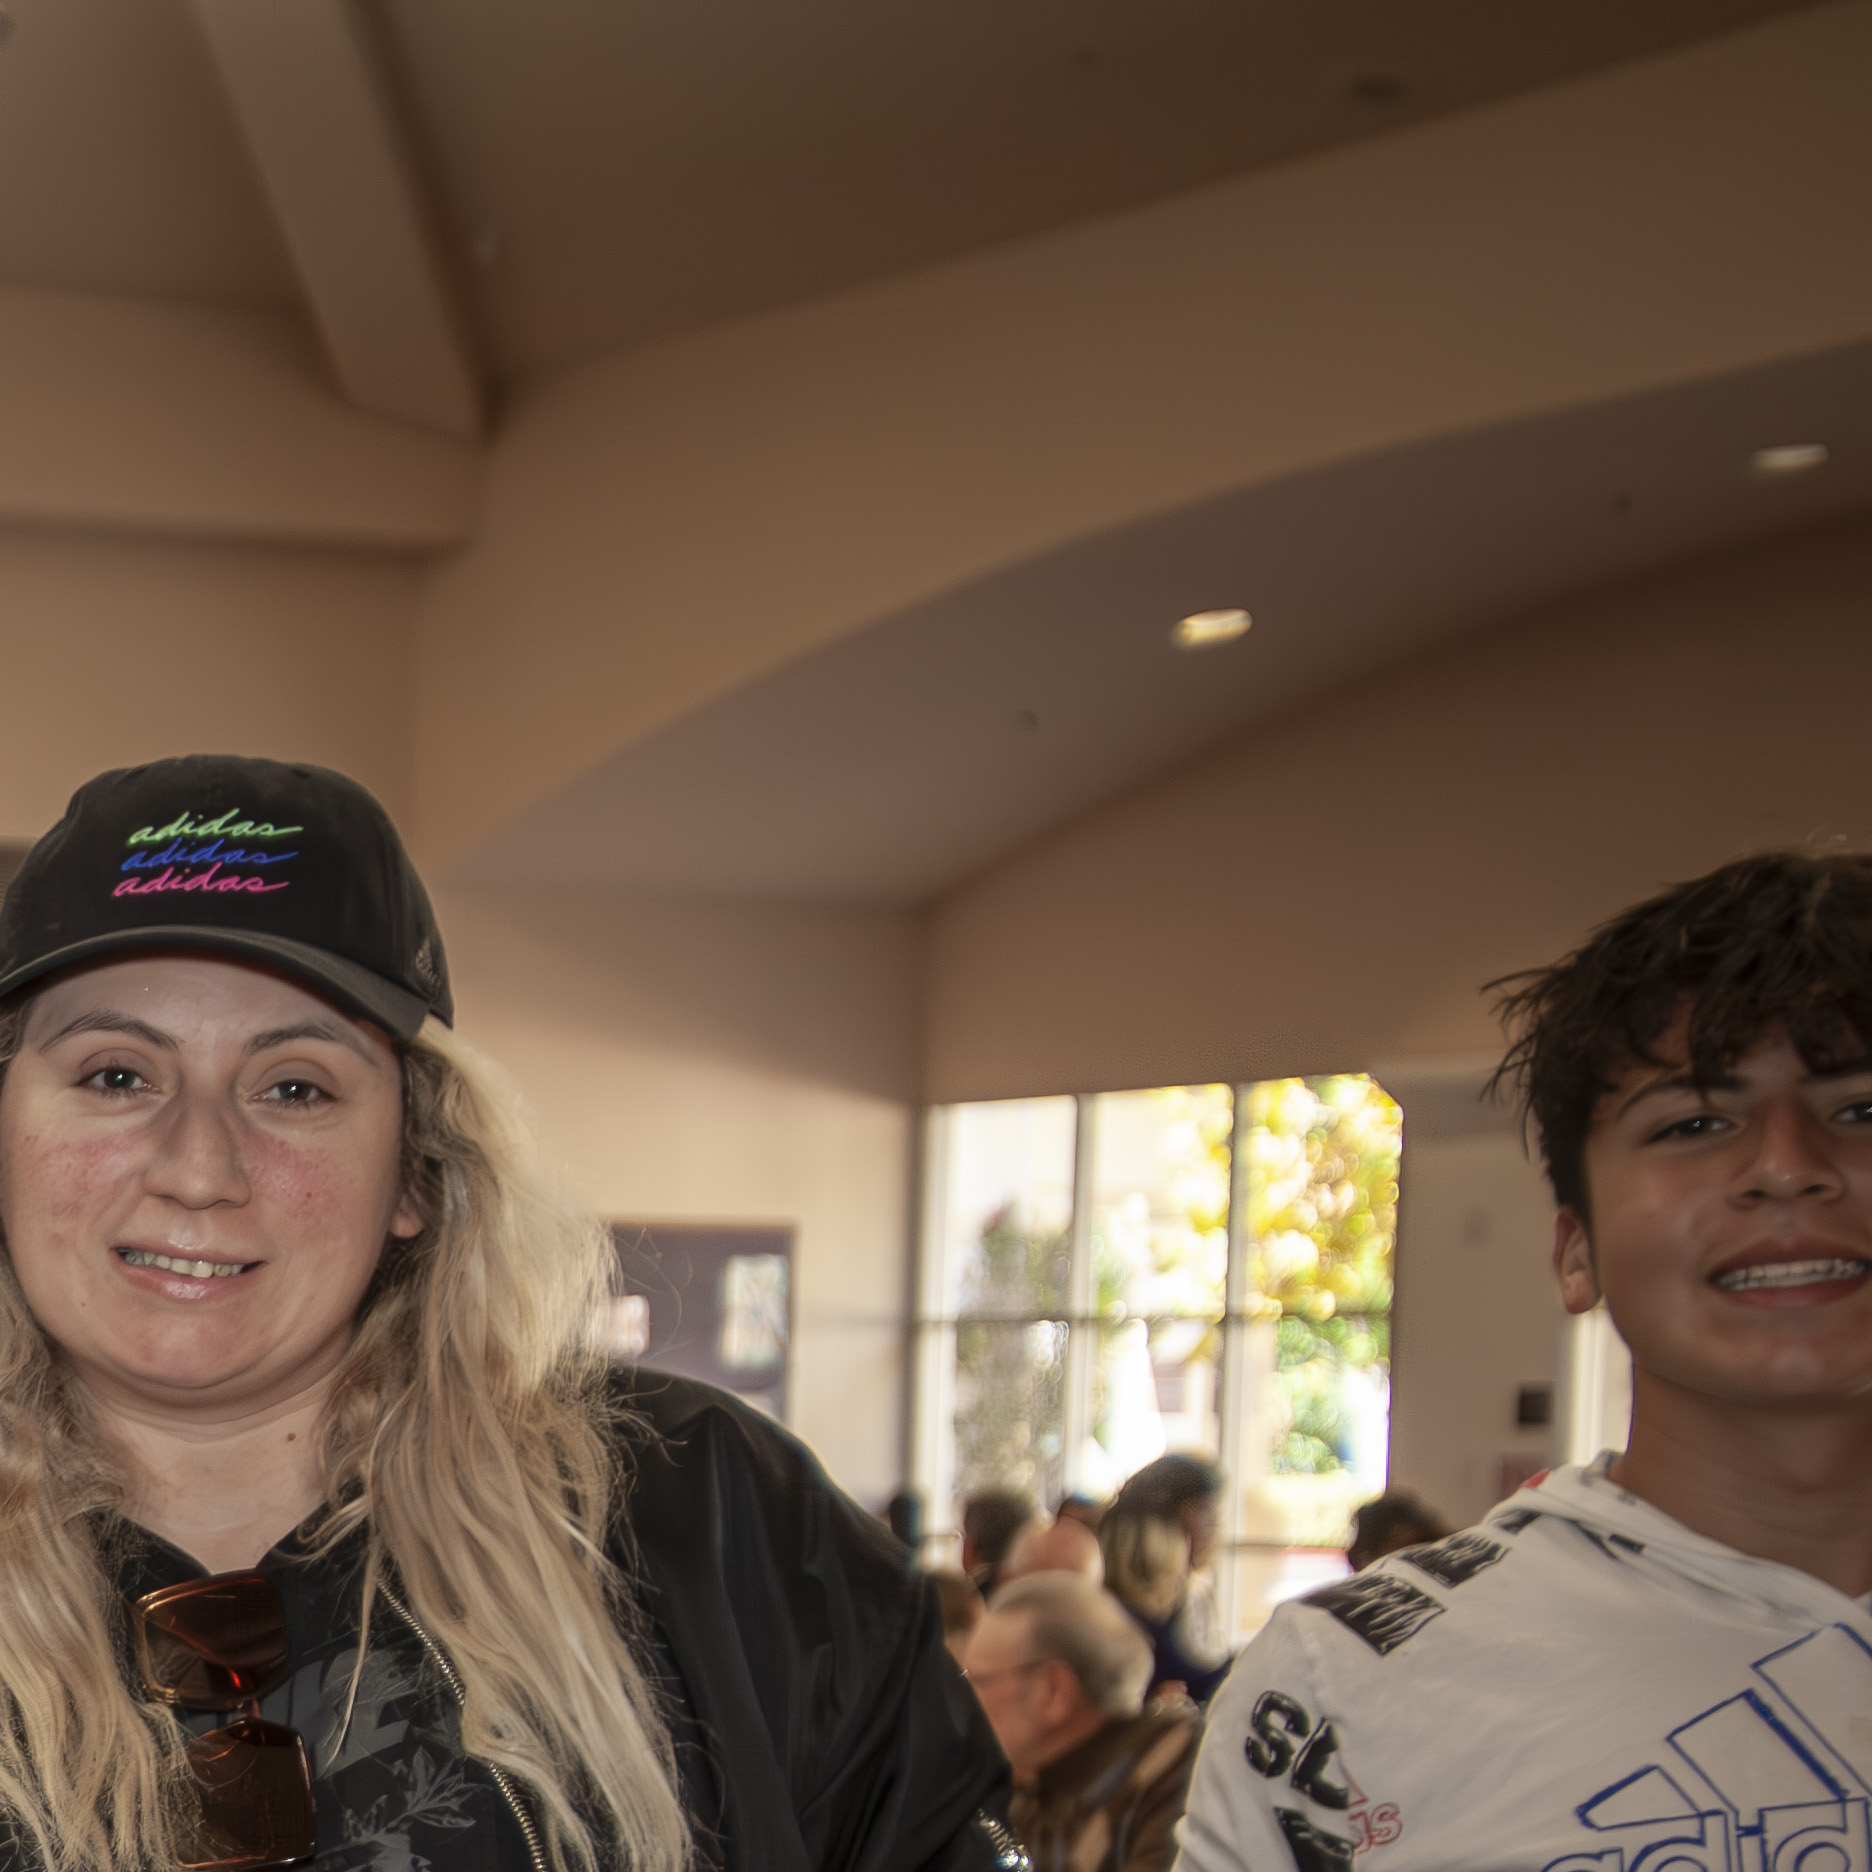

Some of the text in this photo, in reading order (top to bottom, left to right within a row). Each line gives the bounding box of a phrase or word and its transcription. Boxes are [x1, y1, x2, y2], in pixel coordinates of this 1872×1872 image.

[127, 807, 304, 845] adidas
[121, 837, 299, 871] adidas
[113, 861, 290, 897] adidas
